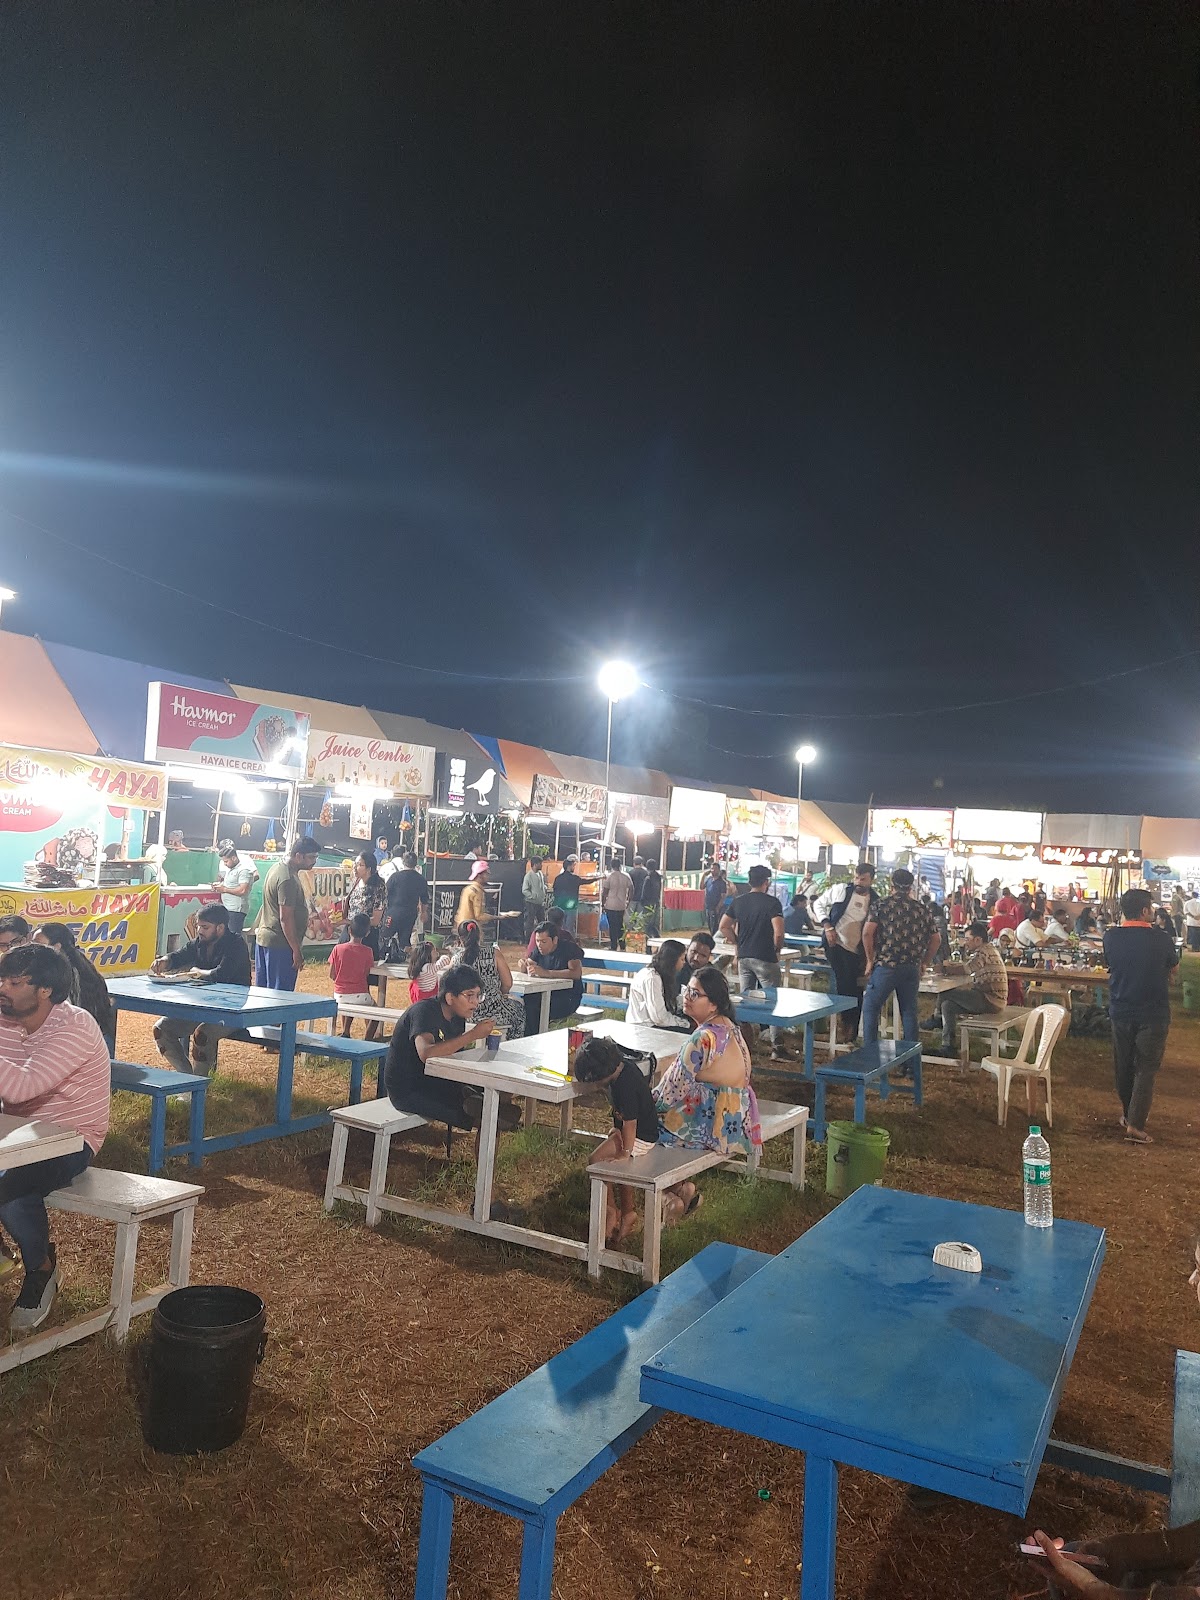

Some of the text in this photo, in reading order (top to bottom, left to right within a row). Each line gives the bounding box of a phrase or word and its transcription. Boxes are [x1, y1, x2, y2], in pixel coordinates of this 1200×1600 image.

[170, 695, 237, 725] Havmor
[186, 719, 219, 731] ICE CREAM
[318, 735, 414, 764] Juice Centre
[200, 755, 225, 767] HAYA
[226, 759, 240, 769] ICE
[87, 766, 161, 800] HAYA
[2, 806, 32, 816] CREAM
[311, 872, 350, 898] JUICE
[91, 893, 152, 915] HAYA
[81, 943, 139, 966] THA
